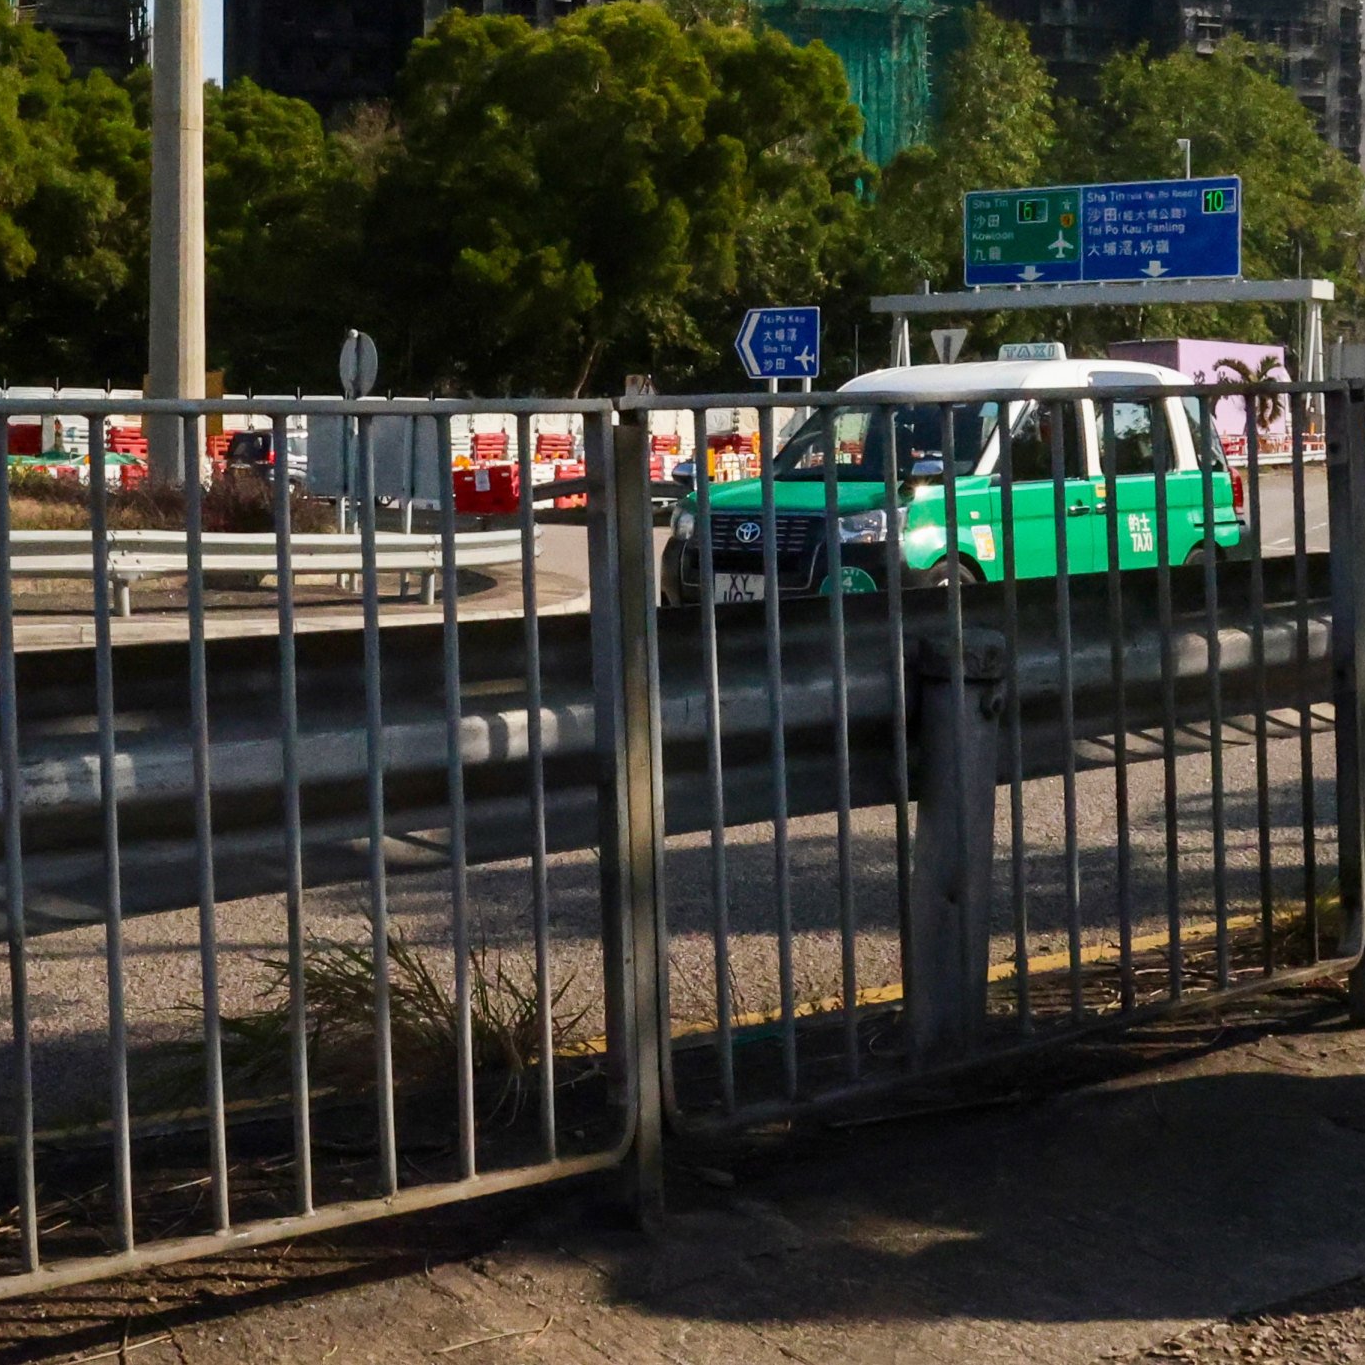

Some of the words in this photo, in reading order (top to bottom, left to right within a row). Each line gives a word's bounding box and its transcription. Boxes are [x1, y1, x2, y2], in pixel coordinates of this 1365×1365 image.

[972, 199, 991, 209] Sha
[994, 198, 1009, 207] Tin
[1087, 192, 1106, 203] Sha
[1110, 191, 1125, 202] Tin
[1206, 190, 1224, 212] 10
[1023, 202, 1033, 221] 6
[973, 214, 1000, 229] 沙田
[1088, 226, 1102, 235] Tai
[1105, 225, 1119, 235] Po
[1146, 222, 1185, 234] Fanling
[972, 231, 1015, 241] Kowloon
[762, 315, 774, 324] Tai
[775, 315, 786, 323] Po
[788, 315, 806, 323] Kau
[763, 345, 778, 353] Sha
[780, 345, 792, 353] Tin
[1003, 345, 1055, 359] TAXI
[763, 358, 786, 372] 沙田
[1127, 513, 1151, 532] 的士
[1130, 532, 1154, 552] TAXI
[729, 574, 750, 590] XY
[842, 577, 853, 587] 4
